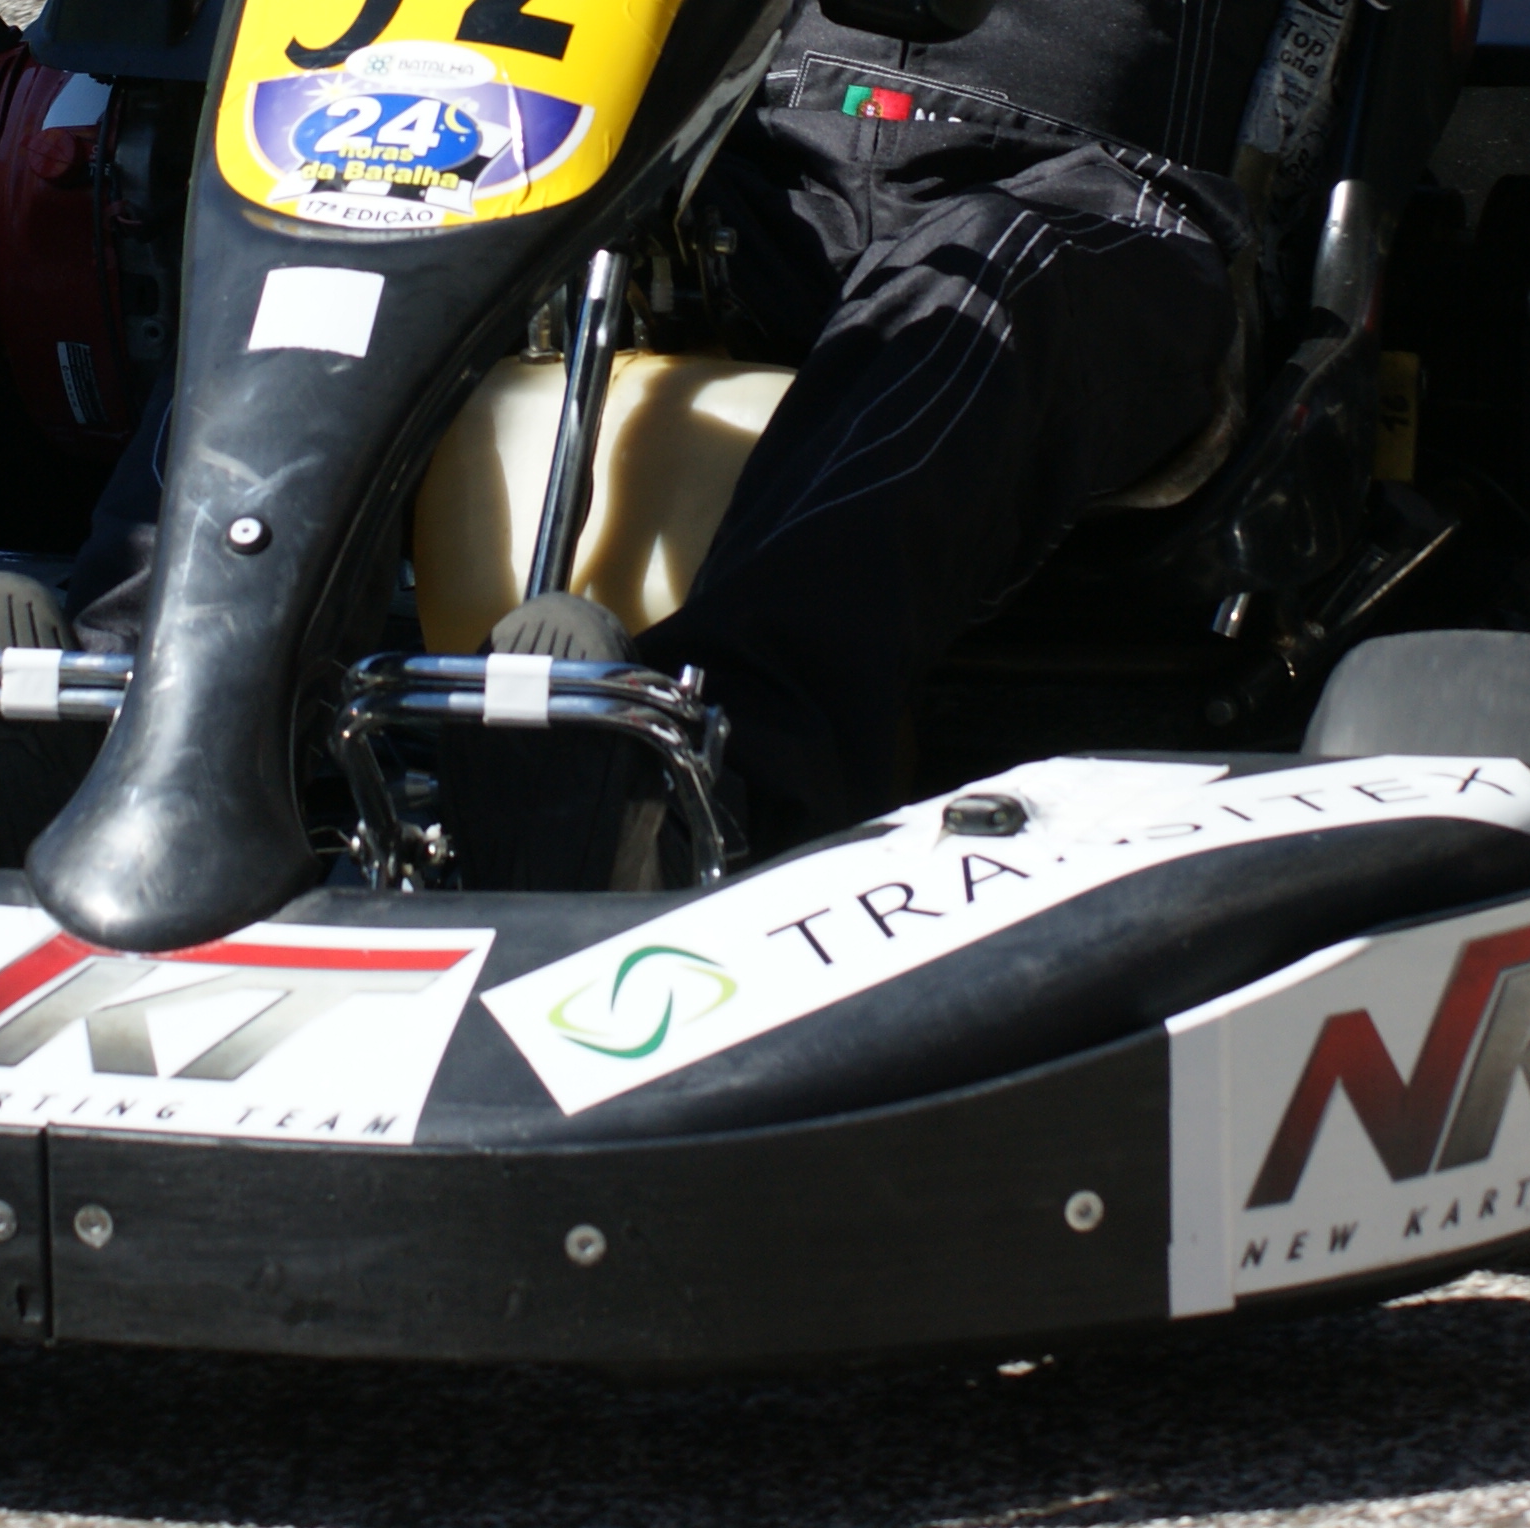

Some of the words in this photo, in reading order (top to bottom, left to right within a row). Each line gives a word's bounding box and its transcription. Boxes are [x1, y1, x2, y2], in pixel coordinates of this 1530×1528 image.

[314, 95, 441, 156] 24
[338, 142, 415, 163] horas
[301, 160, 336, 181] da
[343, 159, 460, 190] Batalha
[342, 206, 434, 223] EDIÇÃO
[767, 766, 1514, 966] TRAITEX
[236, 1106, 398, 1134] TEAM
[1240, 1221, 1358, 1268] NEW
